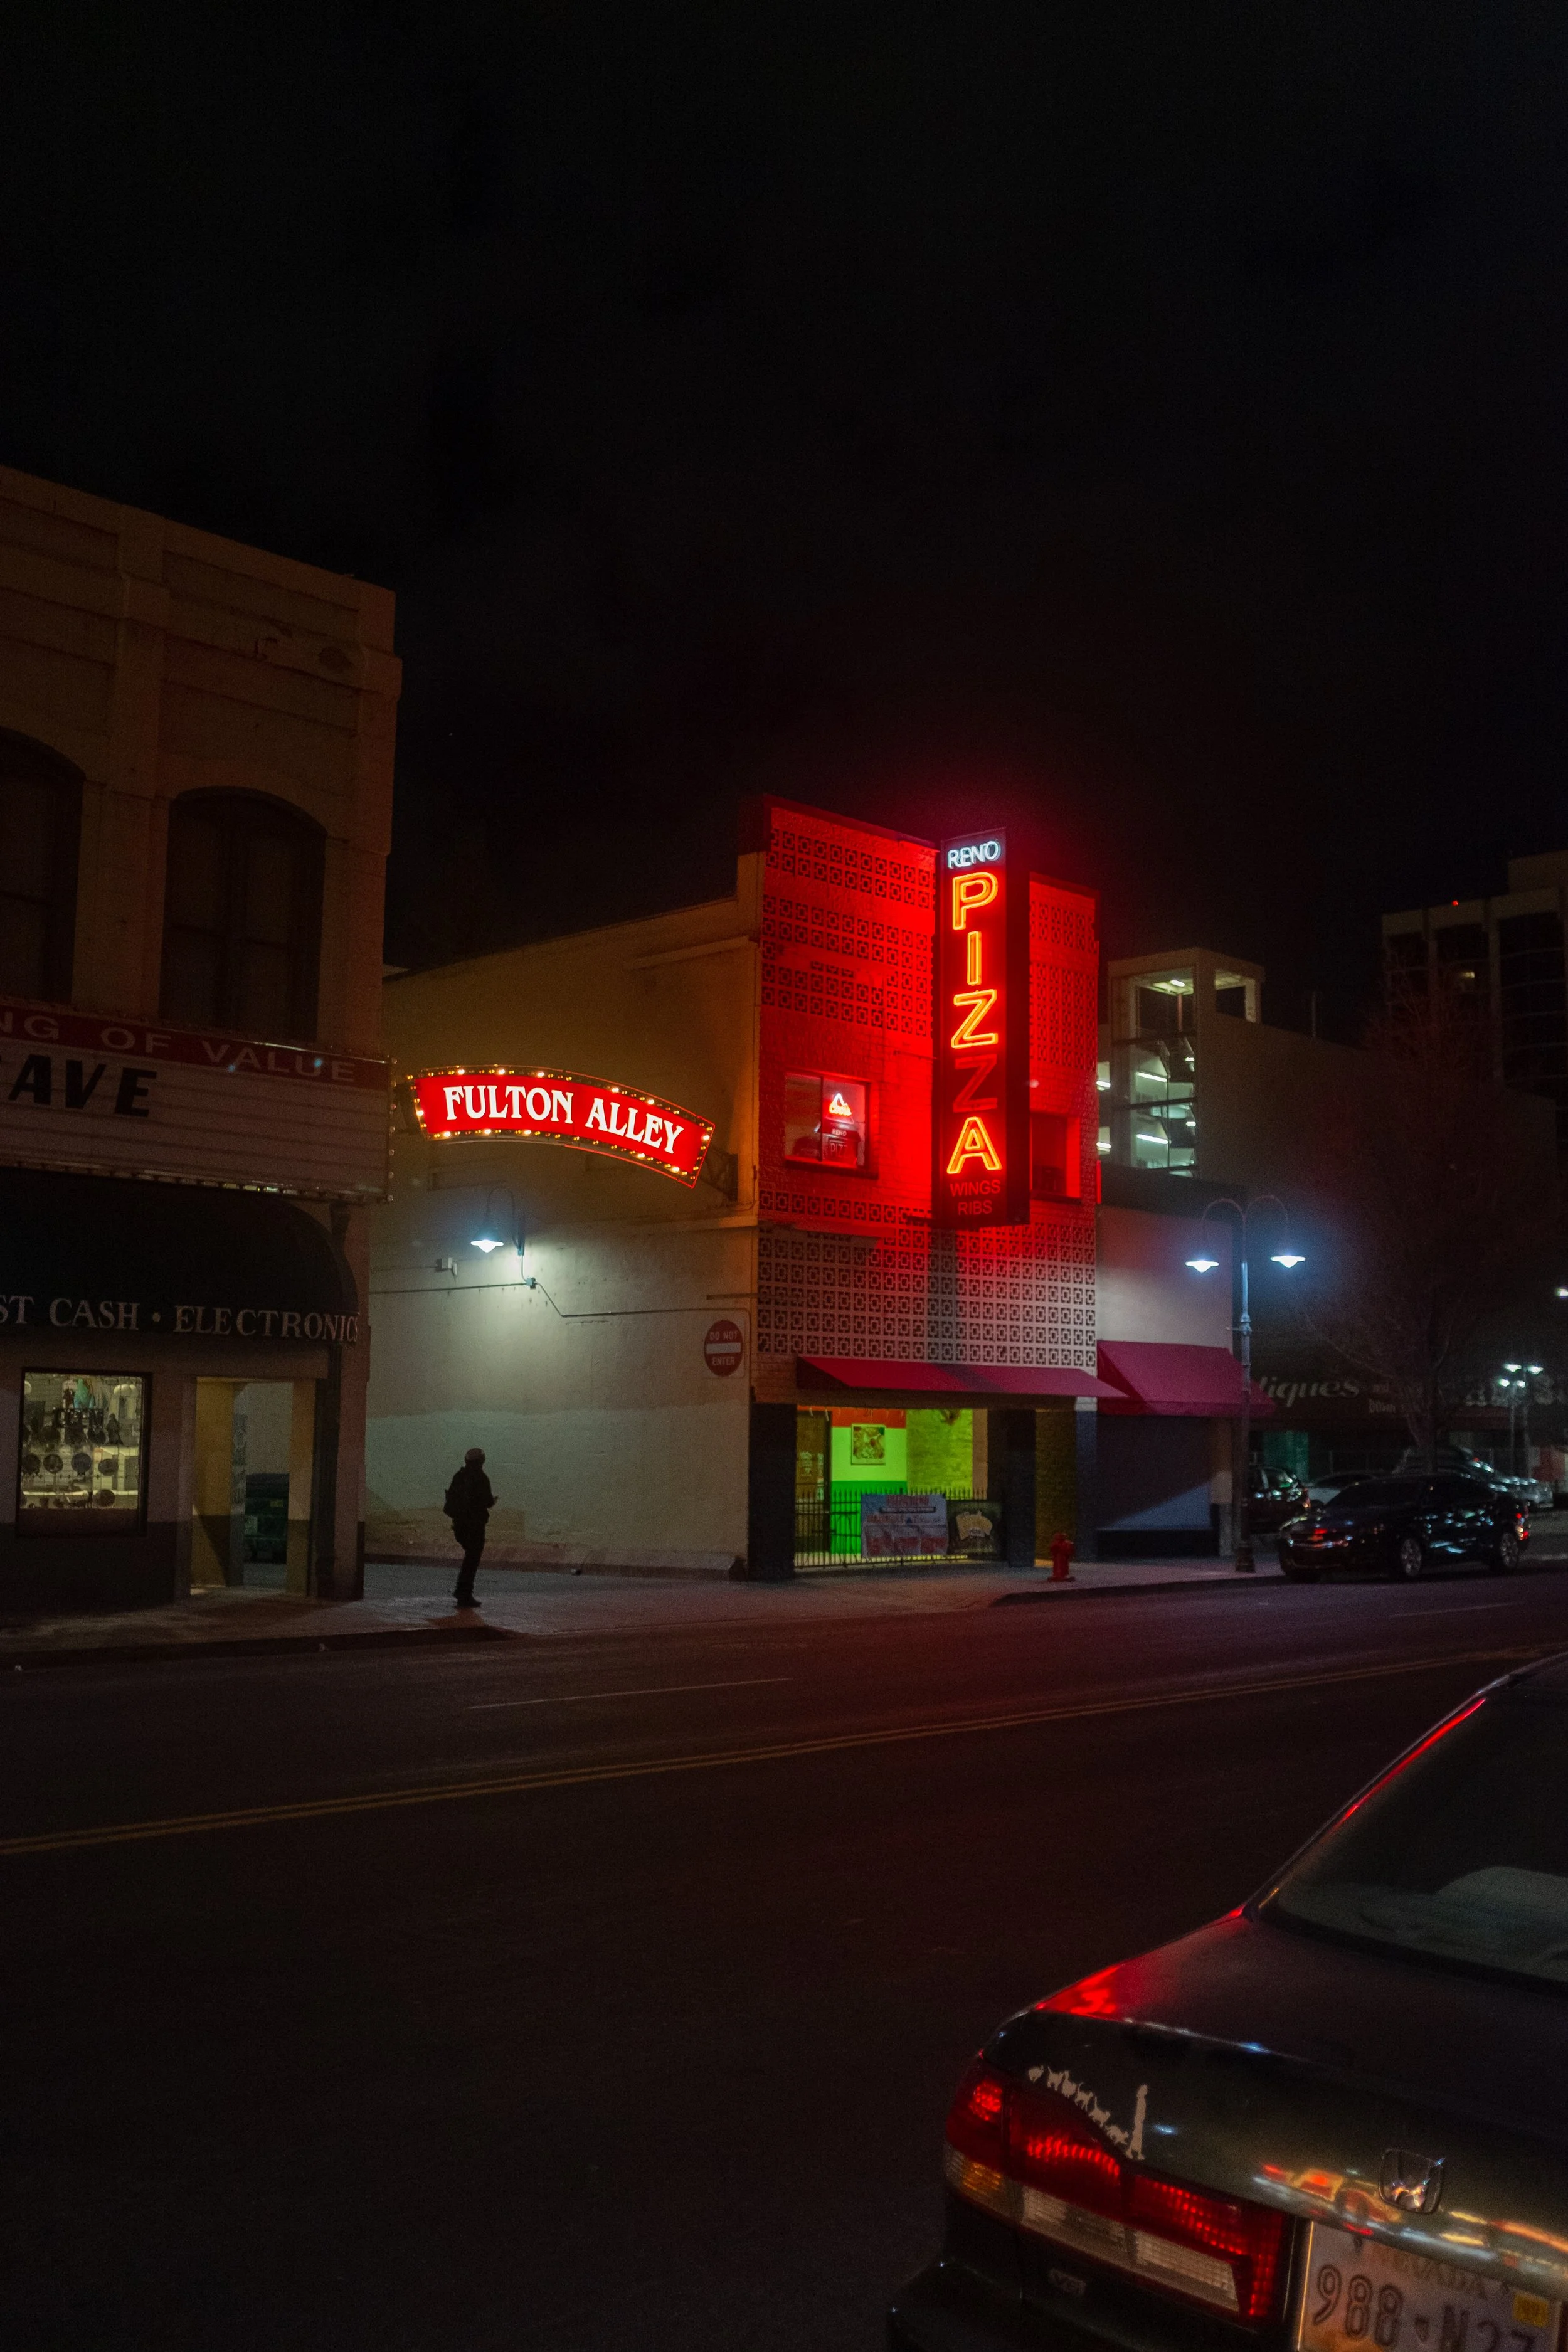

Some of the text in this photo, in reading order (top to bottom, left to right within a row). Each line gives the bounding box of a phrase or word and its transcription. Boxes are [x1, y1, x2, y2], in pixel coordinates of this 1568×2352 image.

[947, 840, 1002, 870] RENO
[946, 871, 1002, 1175] PIZZA
[101, 1026, 172, 1054] OF
[203, 1041, 357, 1083] VALUE
[442, 1085, 684, 1154] FULTON ALLEY
[949, 1179, 1002, 1197] WINGS
[958, 1200, 992, 1216] RIBS
[49, 1297, 141, 1331] CASH
[710, 1331, 738, 1341] DO NOT
[712, 1357, 734, 1365] ENTER
[1313, 2264, 1404, 2348] 988
